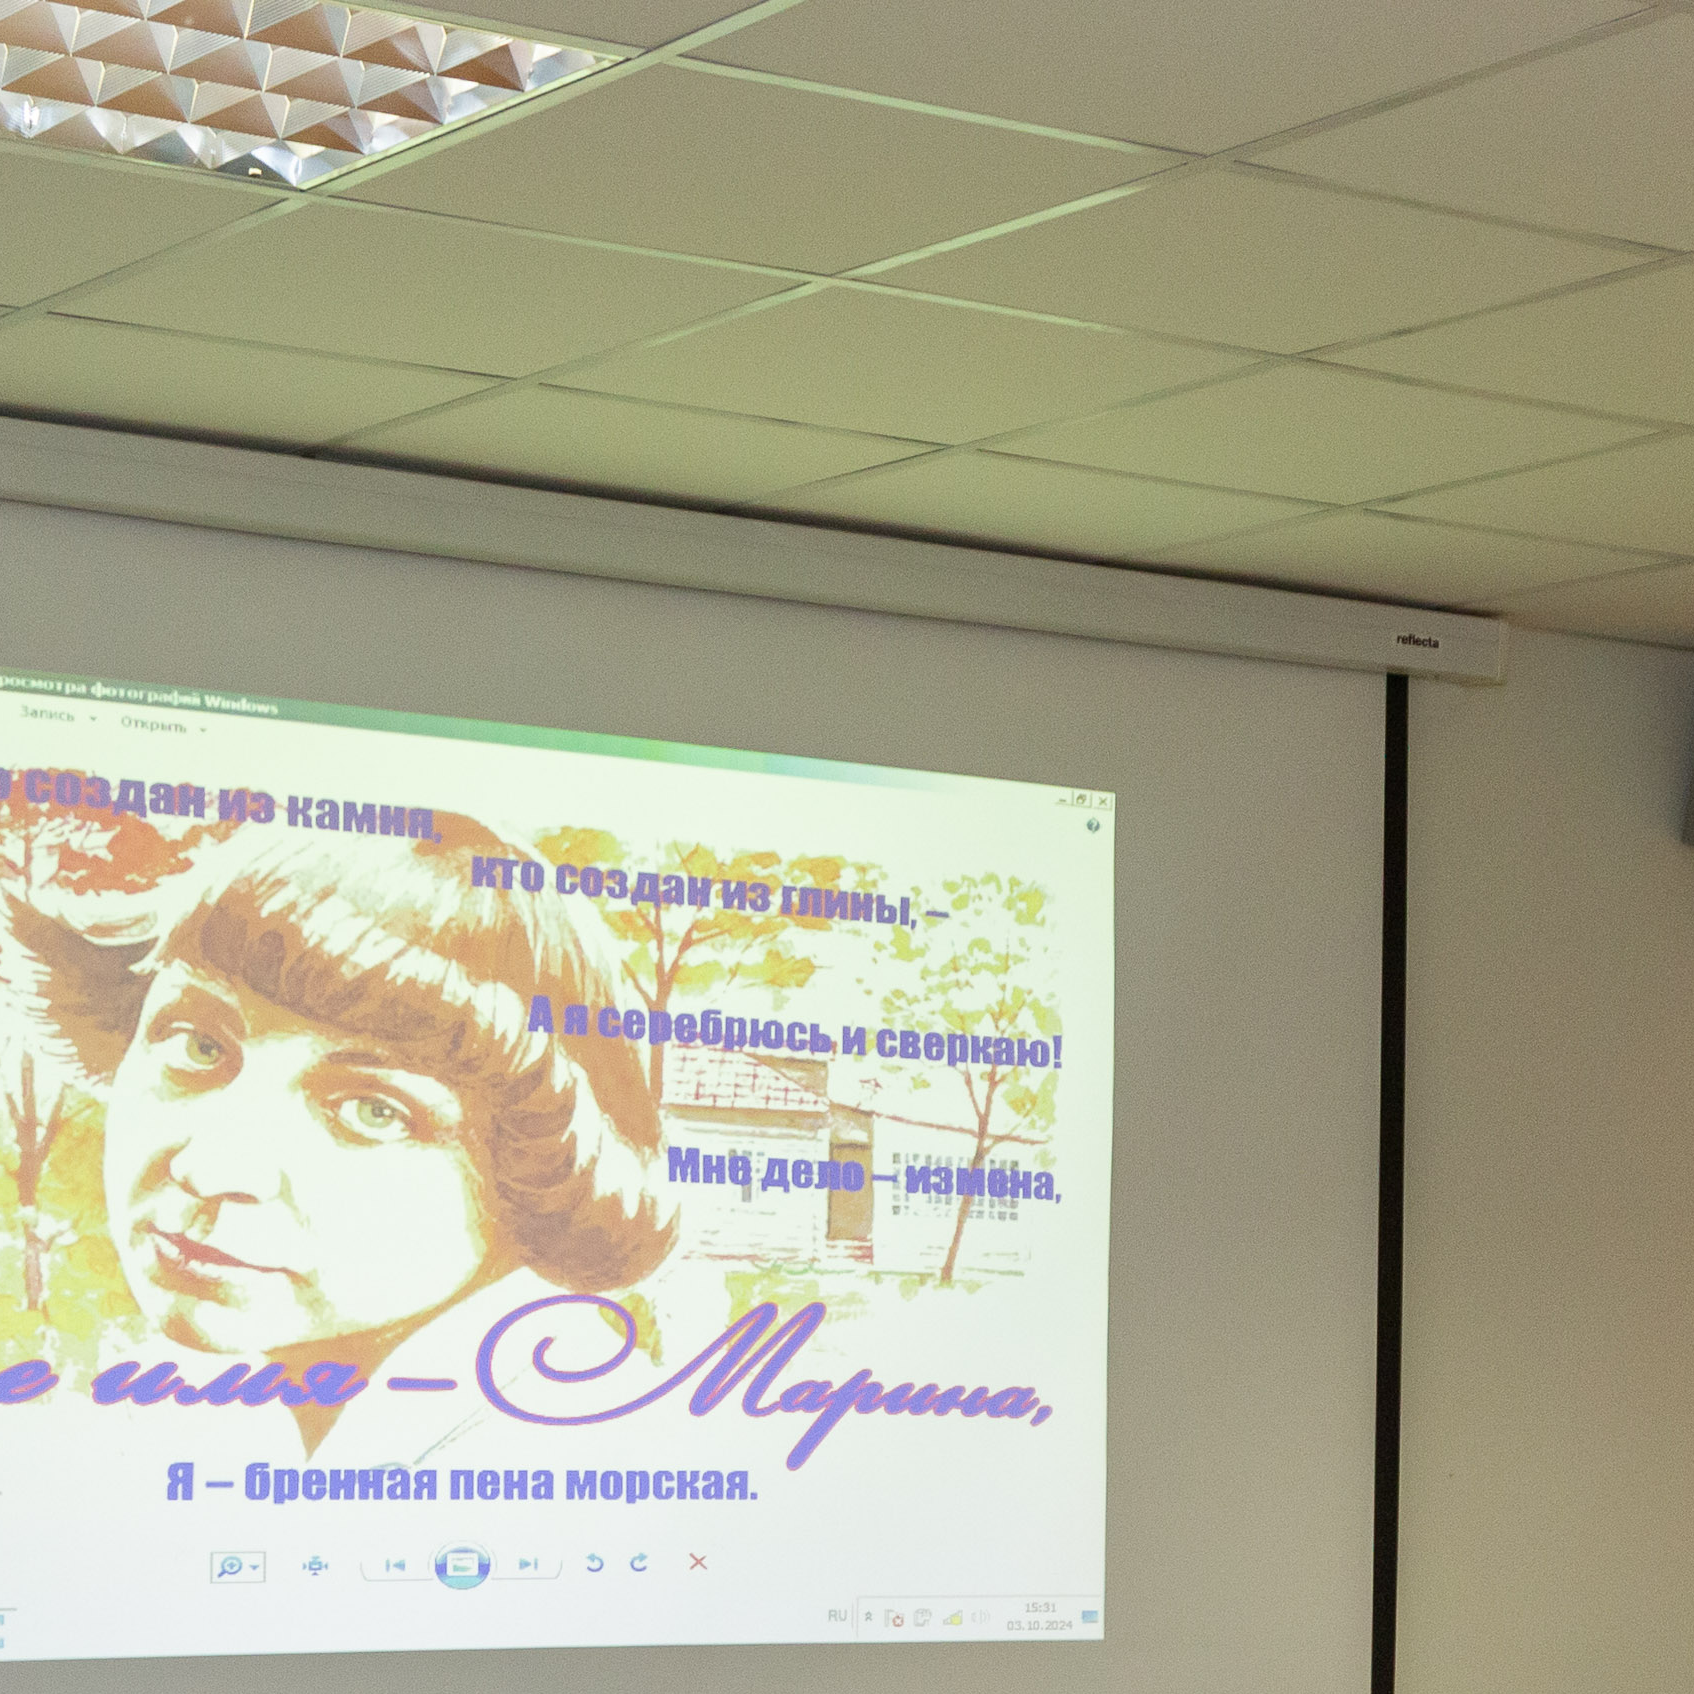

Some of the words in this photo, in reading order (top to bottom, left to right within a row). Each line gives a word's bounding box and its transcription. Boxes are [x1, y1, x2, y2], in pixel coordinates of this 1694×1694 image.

[1396, 633, 1440, 649] reflecta
[20, 705, 75, 722] Запись
[204, 694, 279, 715] Windows
[121, 716, 187, 733] Открыть
[24, 768, 205, 818] создан
[218, 789, 275, 824] из
[287, 795, 442, 844] камня,
[471, 855, 545, 893] кто
[555, 864, 711, 908] создан
[722, 880, 771, 912] из
[781, 885, 916, 930] глины,
[528, 995, 555, 1035] А
[564, 1004, 588, 1036] я
[597, 1006, 832, 1054] серебрюсь
[841, 1025, 867, 1056] и
[876, 1026, 1062, 1069] сверкаю!
[667, 1145, 753, 1187] Мне
[760, 1156, 865, 1193] дело
[904, 1163, 1062, 1204] измена,
[92, 1360, 369, 1407] имя
[475, 1293, 1053, 1472] Марина,
[166, 1461, 195, 1502] Я
[243, 1461, 438, 1505] бренная
[448, 1468, 555, 1502] пена
[564, 1468, 759, 1505] морская.
[827, 1609, 848, 1623] RU
[1024, 1602, 1056, 1614] 15:31
[1006, 1619, 1073, 1632] 03.10.2024
